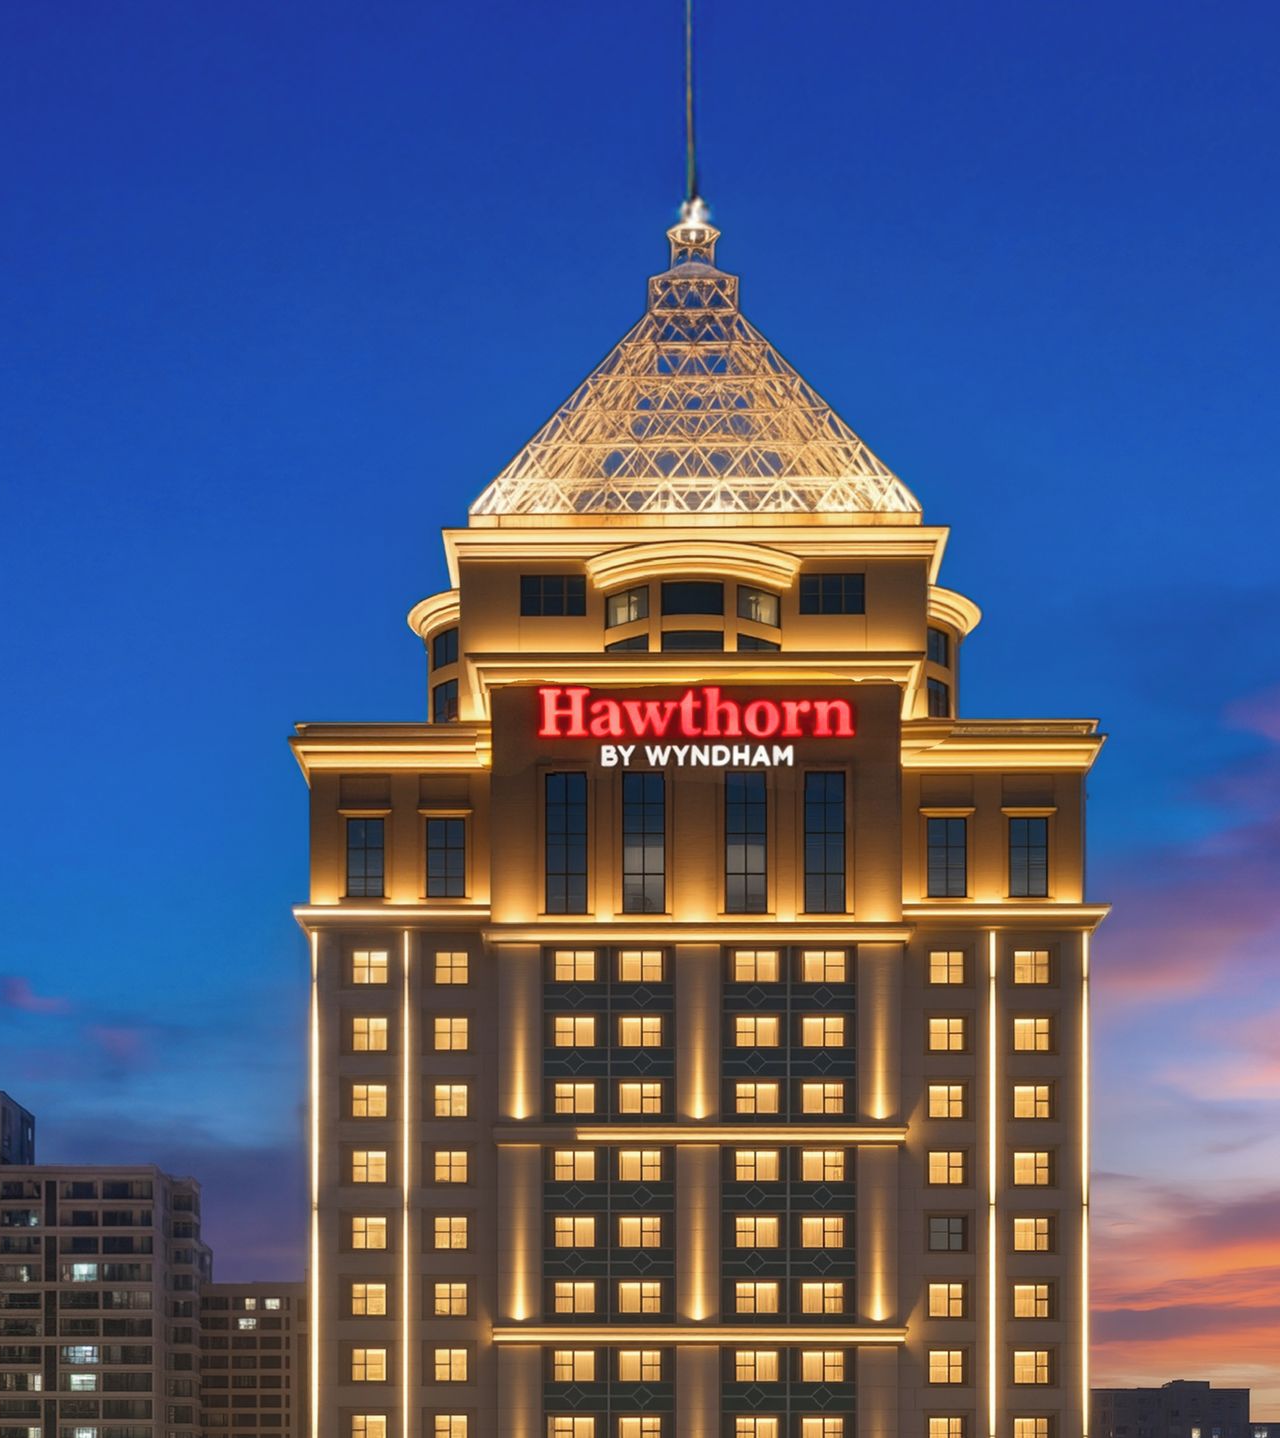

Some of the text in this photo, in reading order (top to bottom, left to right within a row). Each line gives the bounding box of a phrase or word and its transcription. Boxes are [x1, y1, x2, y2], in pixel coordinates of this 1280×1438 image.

[537, 686, 856, 738] Hawthorn
[600, 744, 795, 767] BY WYNDHAM
